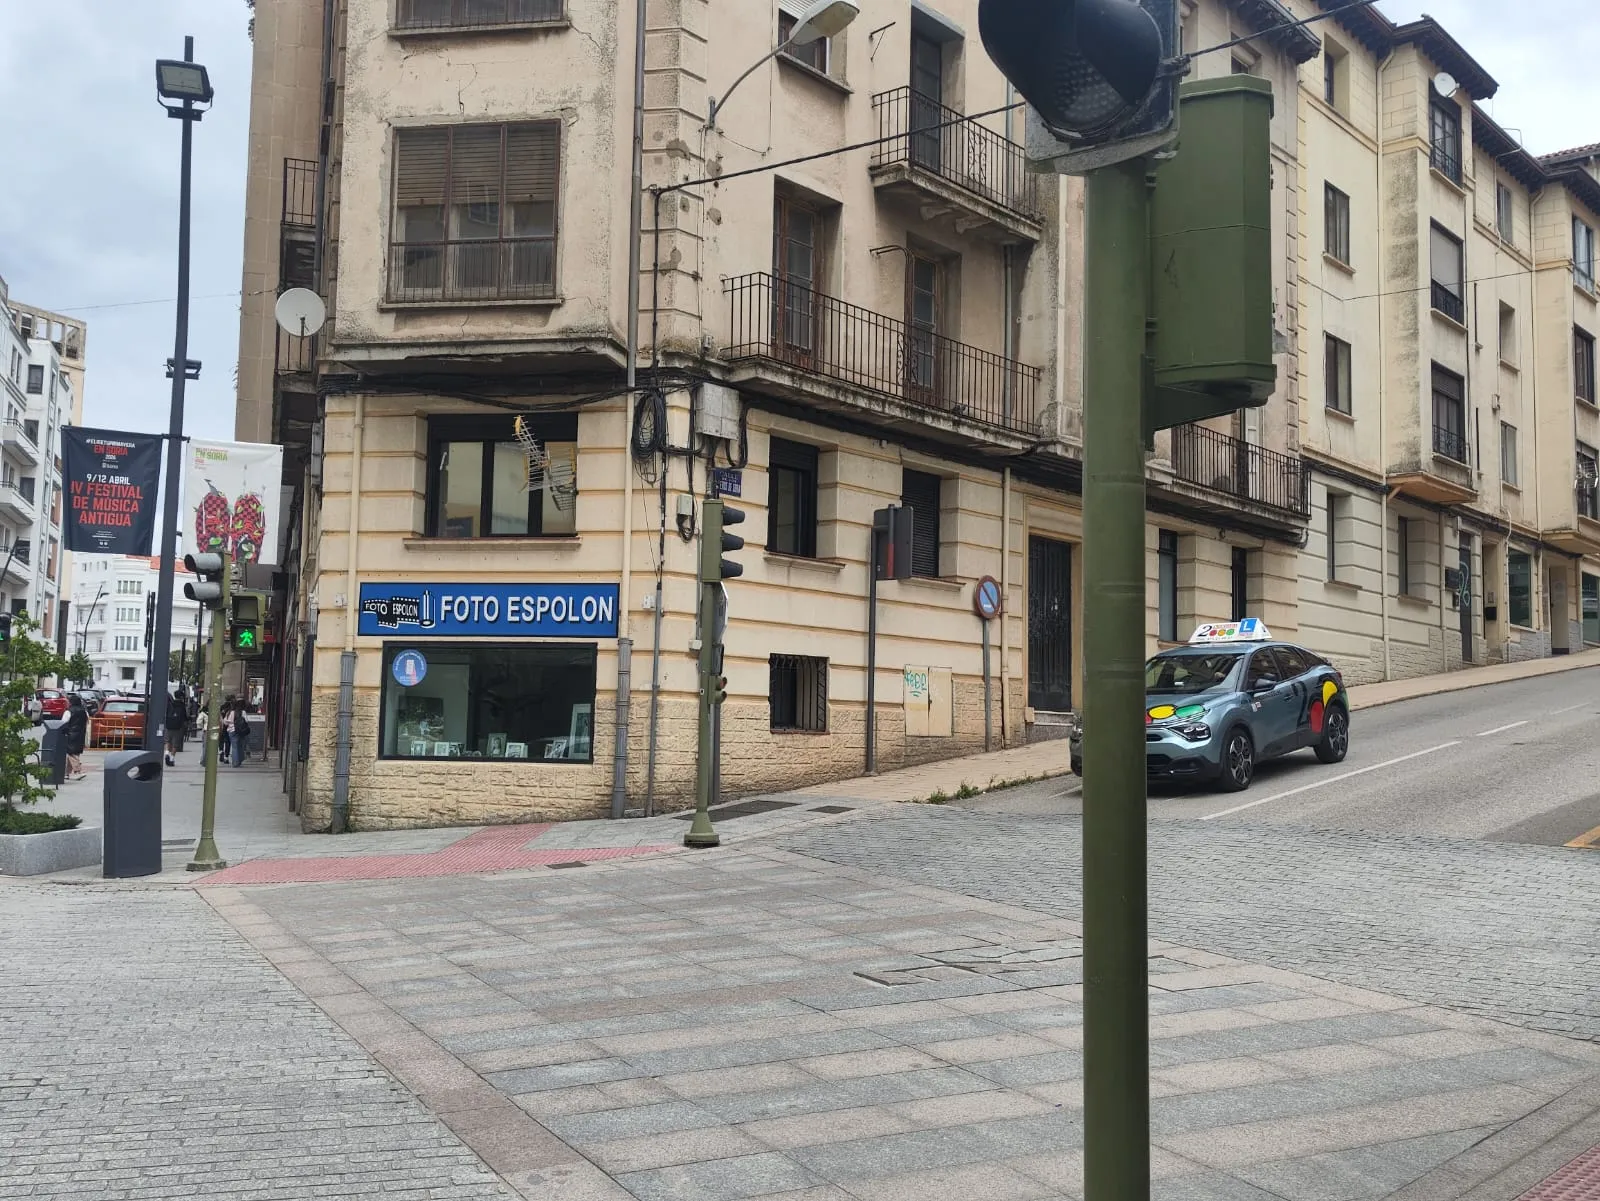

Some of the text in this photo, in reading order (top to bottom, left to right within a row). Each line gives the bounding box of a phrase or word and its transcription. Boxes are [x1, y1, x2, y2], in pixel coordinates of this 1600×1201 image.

[94, 445, 128, 456] EN SORIA
[86, 473, 131, 485] 9/12 ABRIL
[71, 480, 143, 500] IV FESTIVAL
[73, 495, 89, 510] DE
[79, 511, 132, 527] ANTIGUA
[365, 602, 418, 617] FOTO ESPOLON
[440, 595, 613, 622] FOTO ESPOLON
[1243, 620, 1251, 632] L
